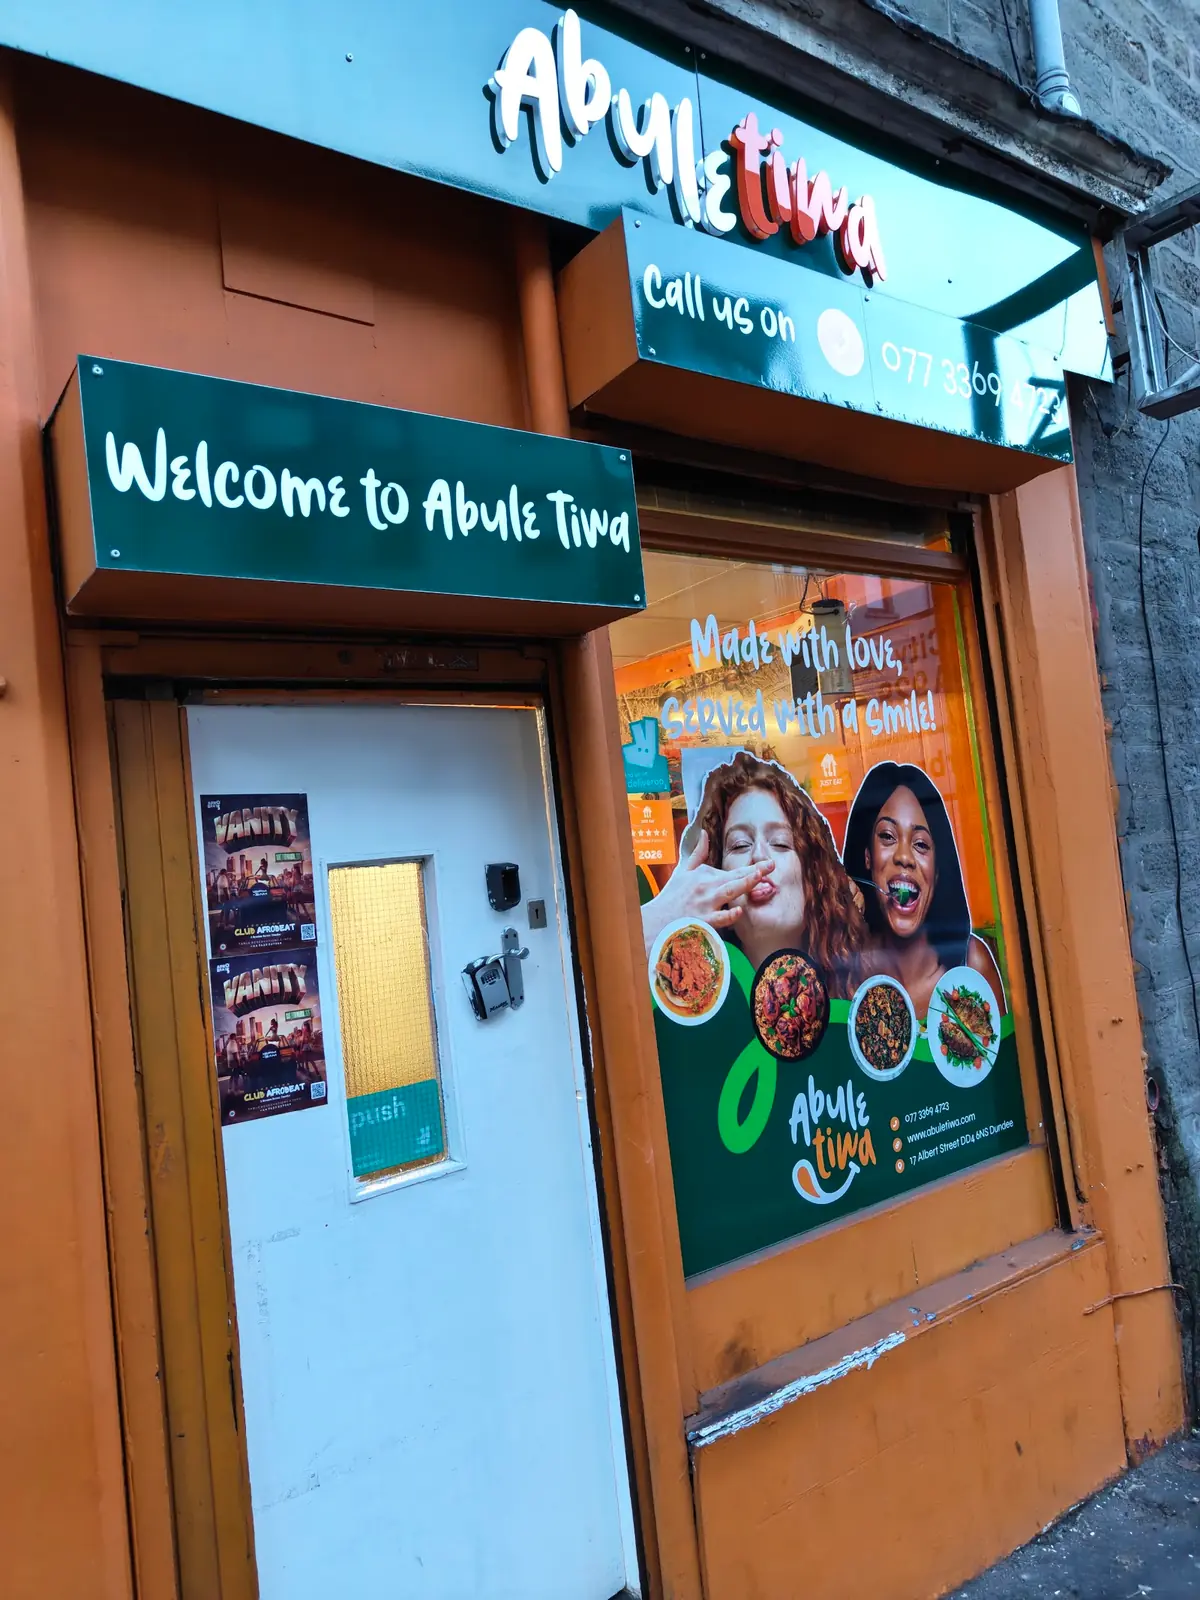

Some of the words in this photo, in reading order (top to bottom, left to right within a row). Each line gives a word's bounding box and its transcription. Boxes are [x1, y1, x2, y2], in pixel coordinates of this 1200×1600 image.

[643, 263, 704, 322] Call
[712, 299, 754, 335] us
[760, 306, 796, 343] on
[881, 341, 932, 388] 077
[941, 360, 1001, 407] 3369
[105, 427, 350, 518] Welcome
[360, 468, 410, 531] to
[423, 478, 541, 542] Abule
[546, 489, 631, 554] Tiwa
[690, 613, 773, 670] Made
[779, 624, 840, 673] with
[846, 624, 903, 677] love,
[773, 690, 835, 739] with
[843, 698, 858, 734] a
[213, 806, 299, 855] VANITY
[234, 927, 256, 937] CLUB
[256, 922, 296, 935] AFROBEAT
[223, 963, 308, 1018] VANITY
[243, 1091, 265, 1102] CLUB
[265, 1082, 306, 1098] AFROBEAT
[351, 1095, 406, 1137] push
[789, 1074, 870, 1147] Abule
[904, 1111, 918, 1123] 077
[918, 1106, 934, 1120] 3369
[934, 1101, 950, 1114] 4723
[906, 1112, 976, 1144] www.abuletiwa.com
[909, 1155, 917, 1166] 17
[917, 1145, 939, 1162] Albert
[939, 1138, 961, 1154] Street
[960, 1133, 976, 1147] DD4
[975, 1126, 990, 1141] 6NS
[988, 1119, 1015, 1136] Dundee
[812, 1127, 877, 1180] tiwa
